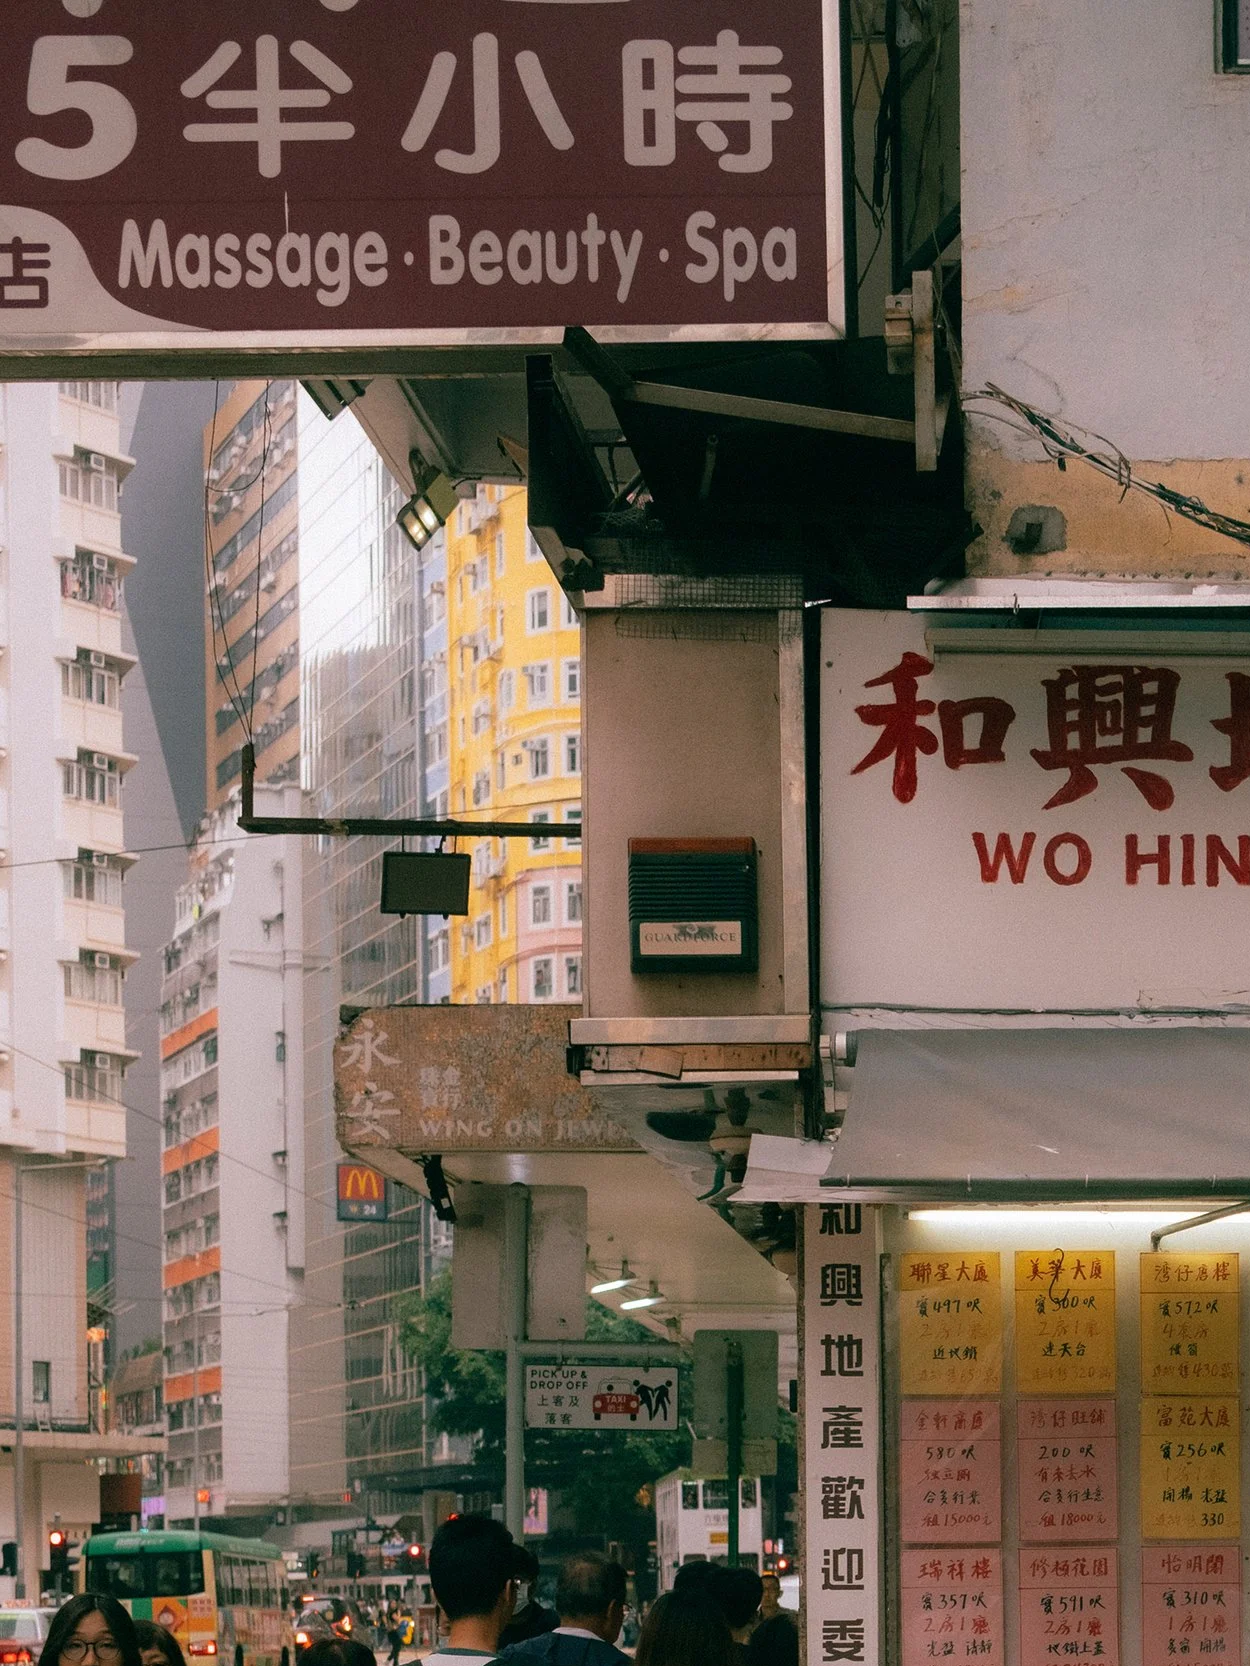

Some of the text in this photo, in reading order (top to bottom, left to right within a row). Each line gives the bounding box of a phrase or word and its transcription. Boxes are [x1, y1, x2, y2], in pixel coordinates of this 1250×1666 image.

[15, 29, 794, 181] 5半小時
[118, 211, 797, 308] Massage Beauty Spa
[972, 832, 1093, 886] WO
[645, 932, 737, 943] GUARDFORCE
[340, 1019, 401, 1140] 永安
[421, 1119, 492, 1138] WING
[505, 1119, 543, 1138] ON
[531, 1370, 587, 1378] PICK UP &
[530, 1381, 588, 1389] DROP OFF
[537, 1395, 579, 1407] 上客及
[606, 1395, 626, 1403] TAXI
[1039, 1446, 1094, 1460] 200呎
